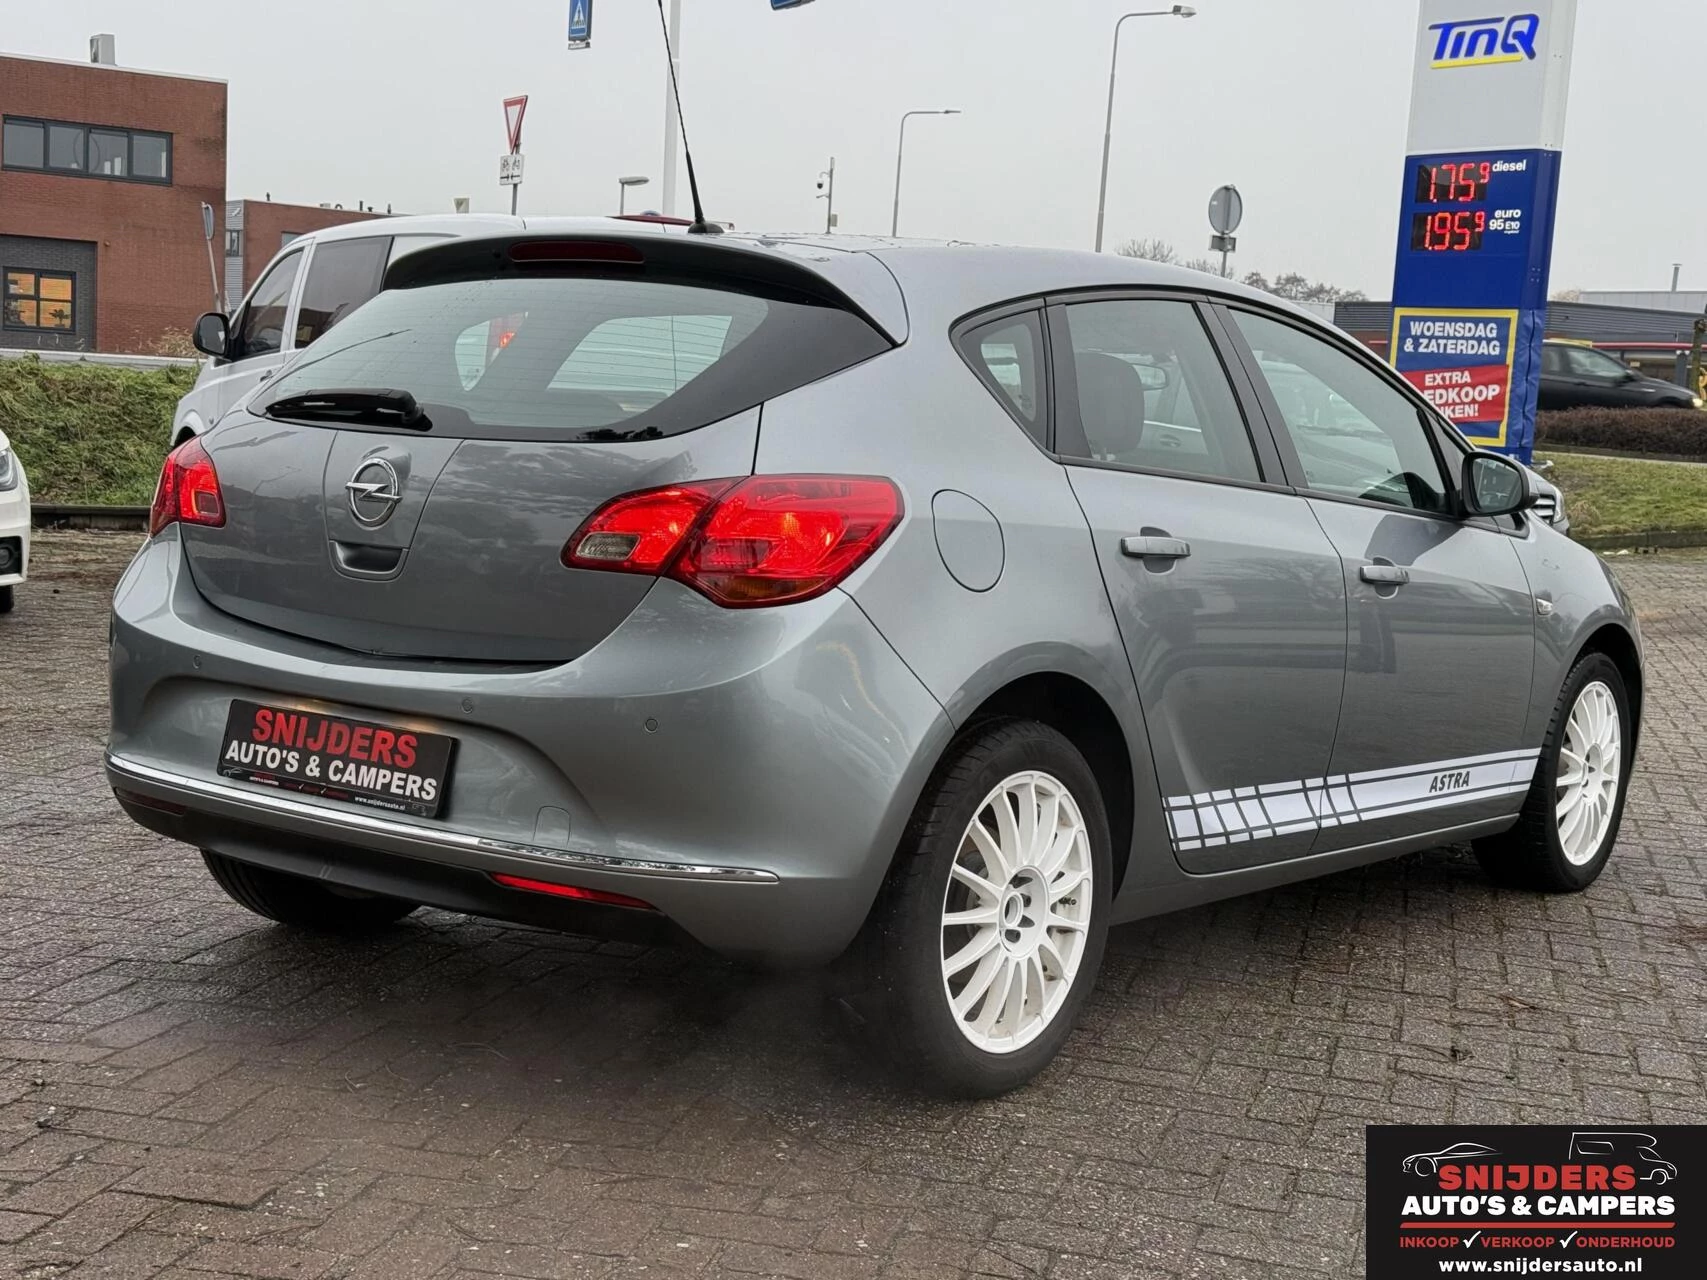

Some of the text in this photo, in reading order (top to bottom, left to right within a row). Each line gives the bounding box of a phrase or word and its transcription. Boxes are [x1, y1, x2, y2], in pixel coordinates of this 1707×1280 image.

[1492, 159, 1527, 172] diesel
[1494, 209, 1521, 218] euro
[1489, 219, 1504, 230] 95
[1505, 221, 1520, 230] E10
[1410, 321, 1497, 338] WOENSDAG
[1403, 338, 1500, 355] & ZATERDAG
[1425, 371, 1471, 386] EXTRA
[1423, 384, 1500, 405] EDKOOP
[252, 709, 418, 769] SNIJDERS
[225, 739, 300, 773] AUTO'S
[305, 755, 321, 777] &
[328, 760, 437, 801] CAMPERS
[1429, 771, 1470, 793] ASTRA
